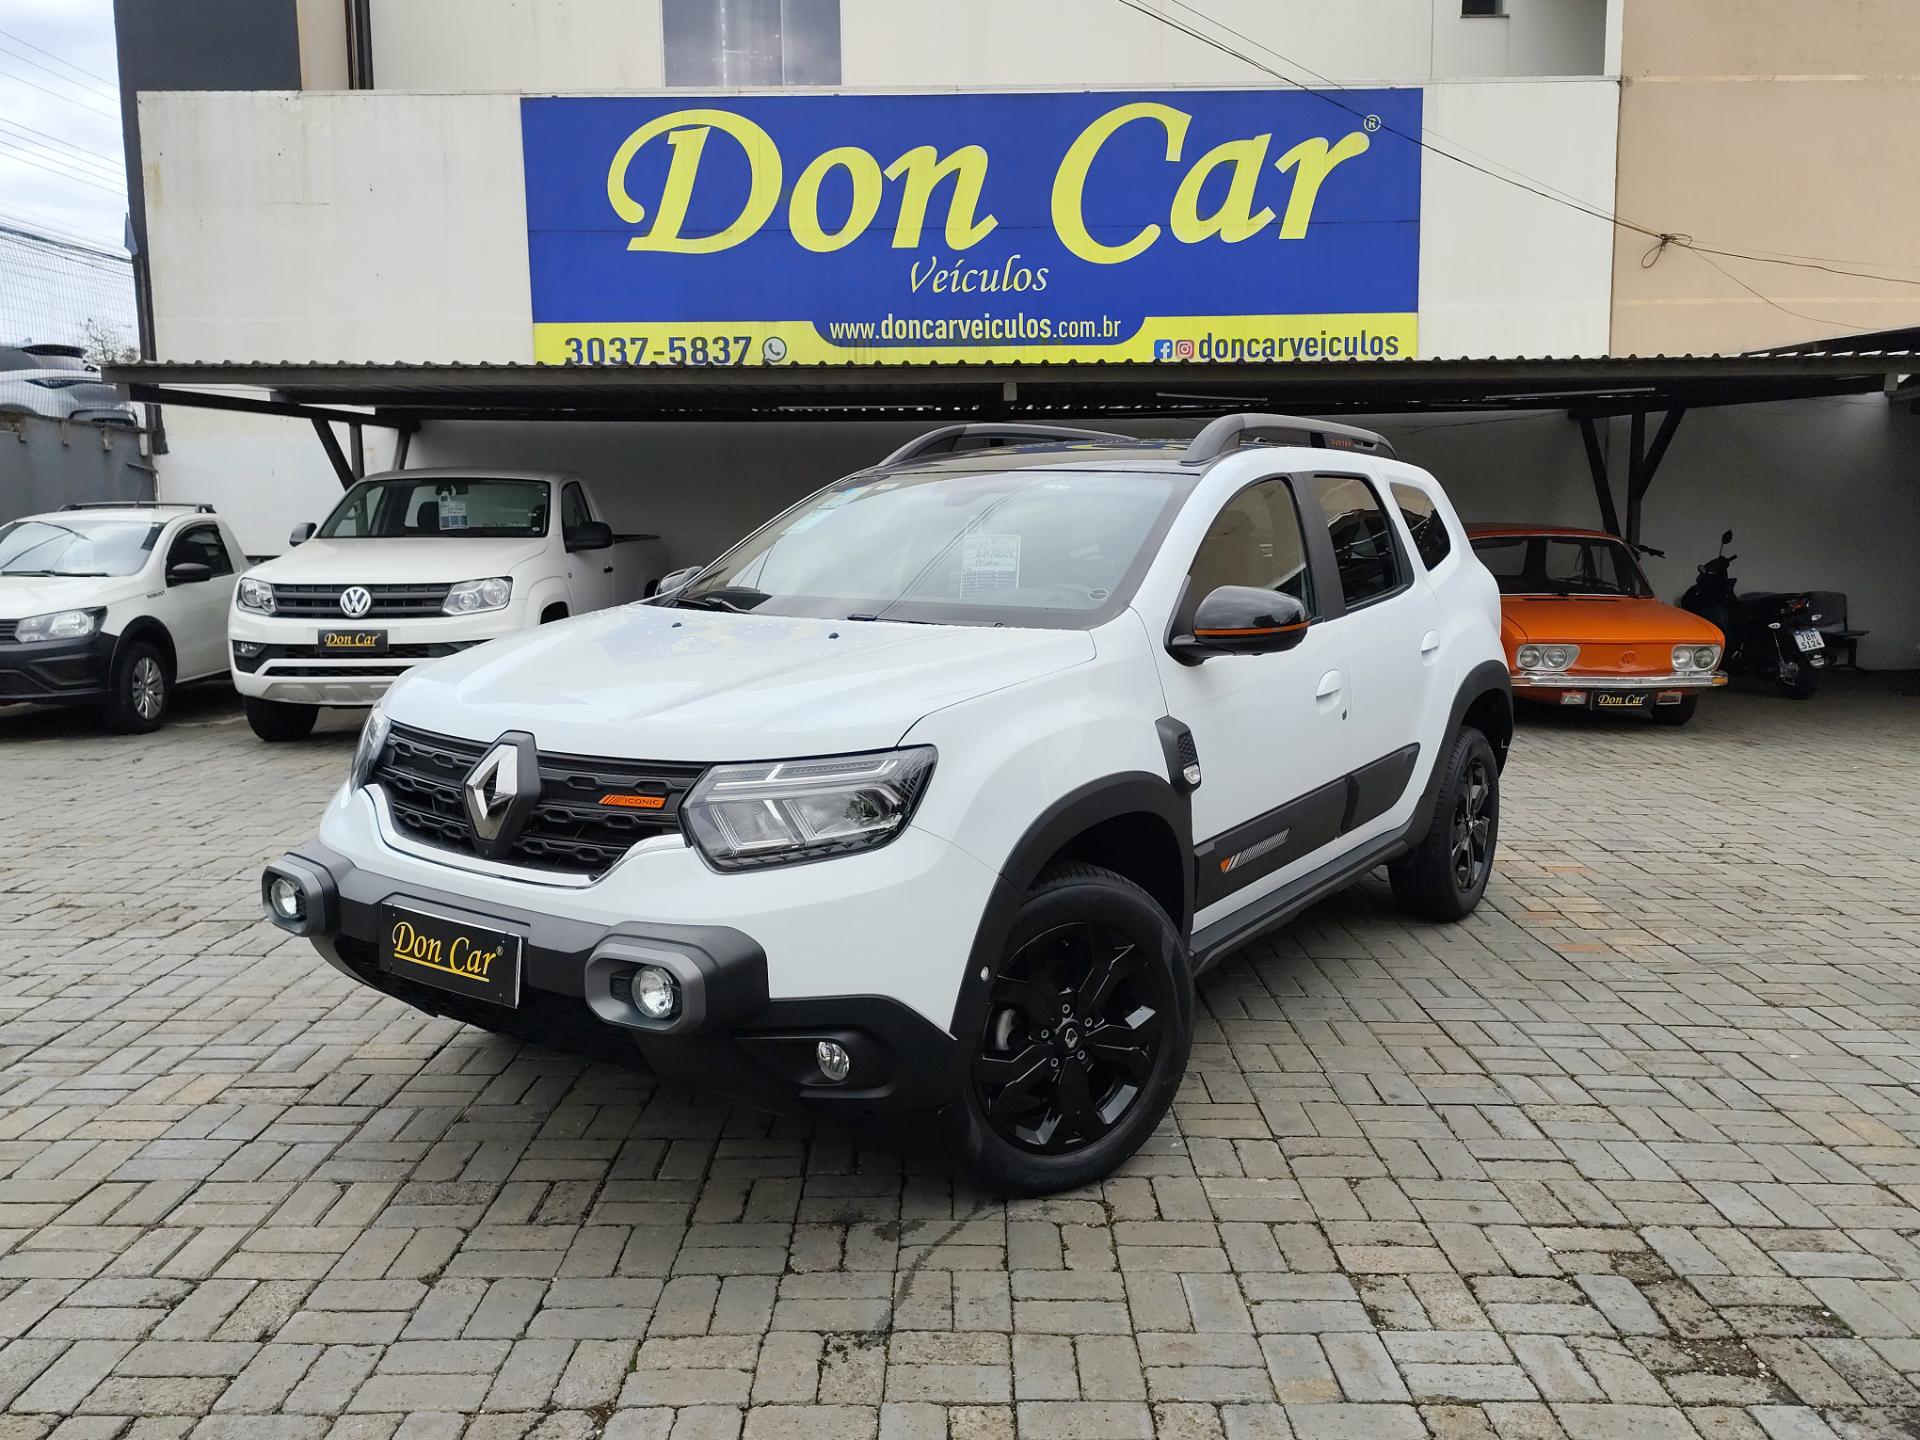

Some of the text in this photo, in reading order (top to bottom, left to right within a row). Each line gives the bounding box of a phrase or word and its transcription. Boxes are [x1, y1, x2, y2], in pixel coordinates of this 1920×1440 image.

[607, 109, 999, 254] Don
[910, 254, 1049, 293] Veículos
[829, 312, 1121, 340] www.doncarveiculos.com.br
[565, 336, 752, 365] 3037-5837
[1199, 329, 1399, 359] doncarveiculos
[324, 633, 352, 646] Don
[1598, 694, 1622, 704] Don
[625, 797, 659, 806] ICONIC
[392, 921, 442, 963] Don
